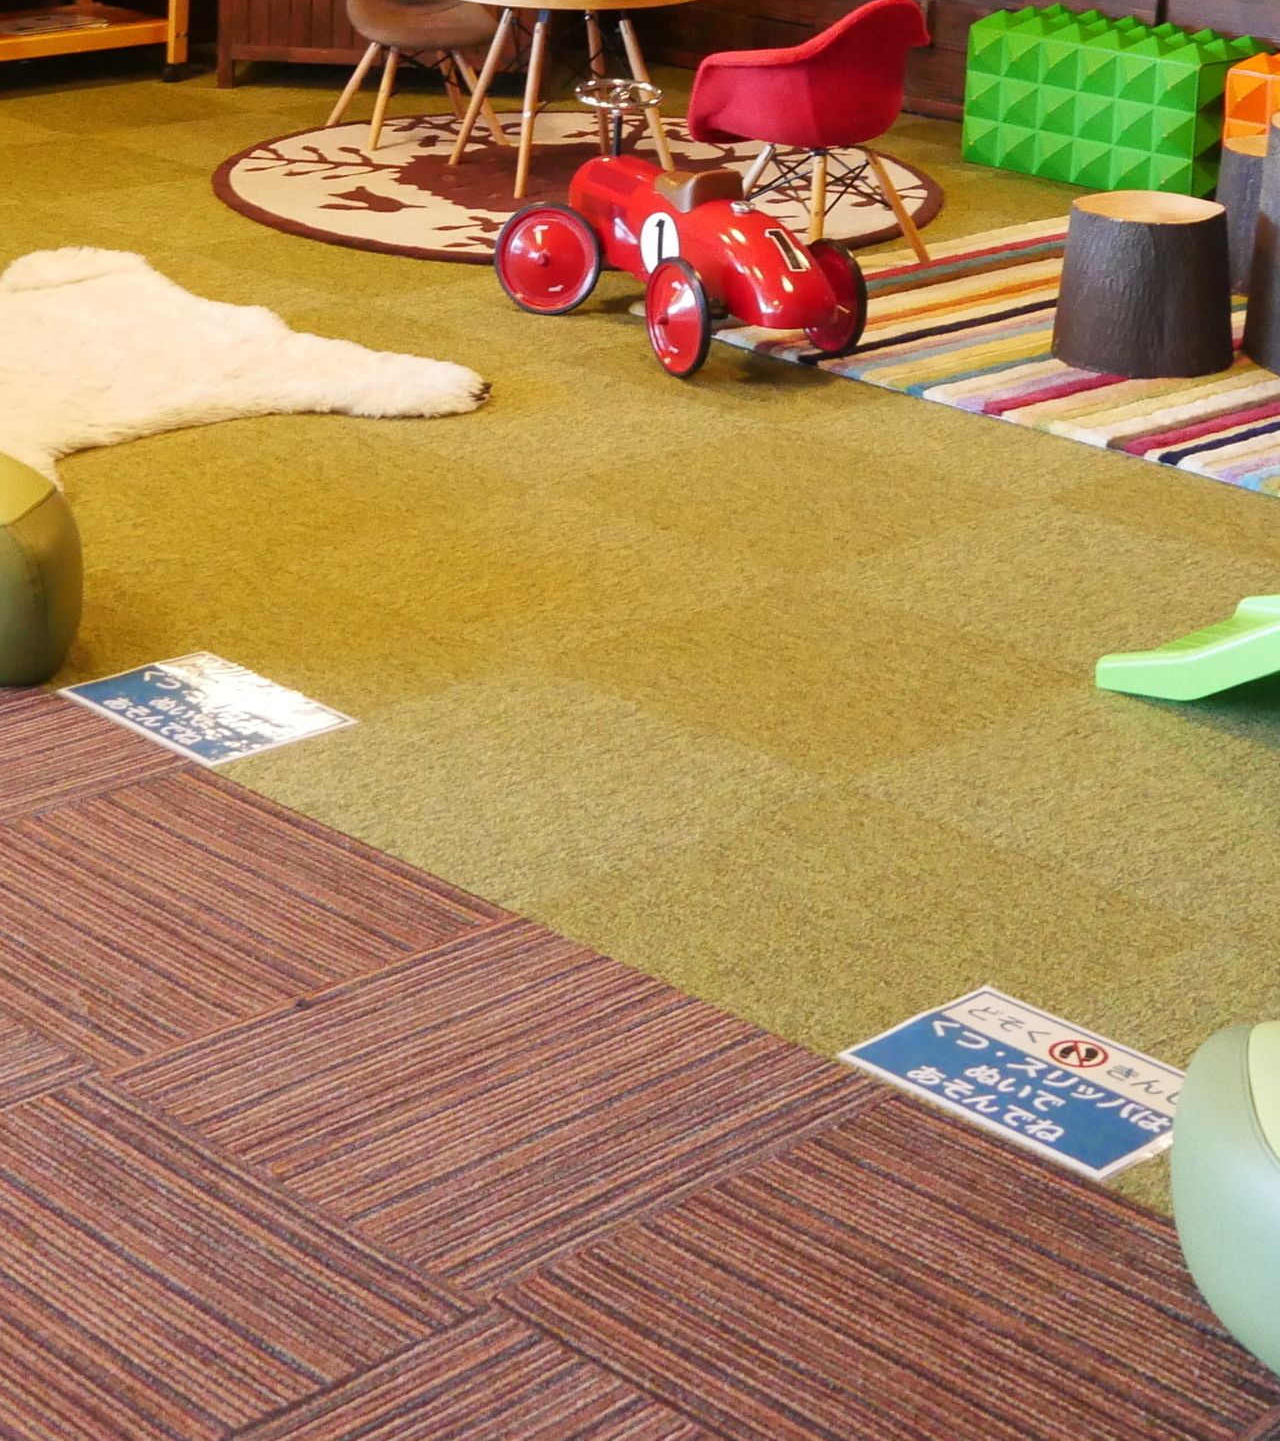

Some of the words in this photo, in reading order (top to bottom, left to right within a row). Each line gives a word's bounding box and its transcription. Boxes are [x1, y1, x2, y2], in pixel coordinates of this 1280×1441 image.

[906, 1065, 1065, 1143] あそんでね
[964, 1063, 1066, 1112] ぬいで
